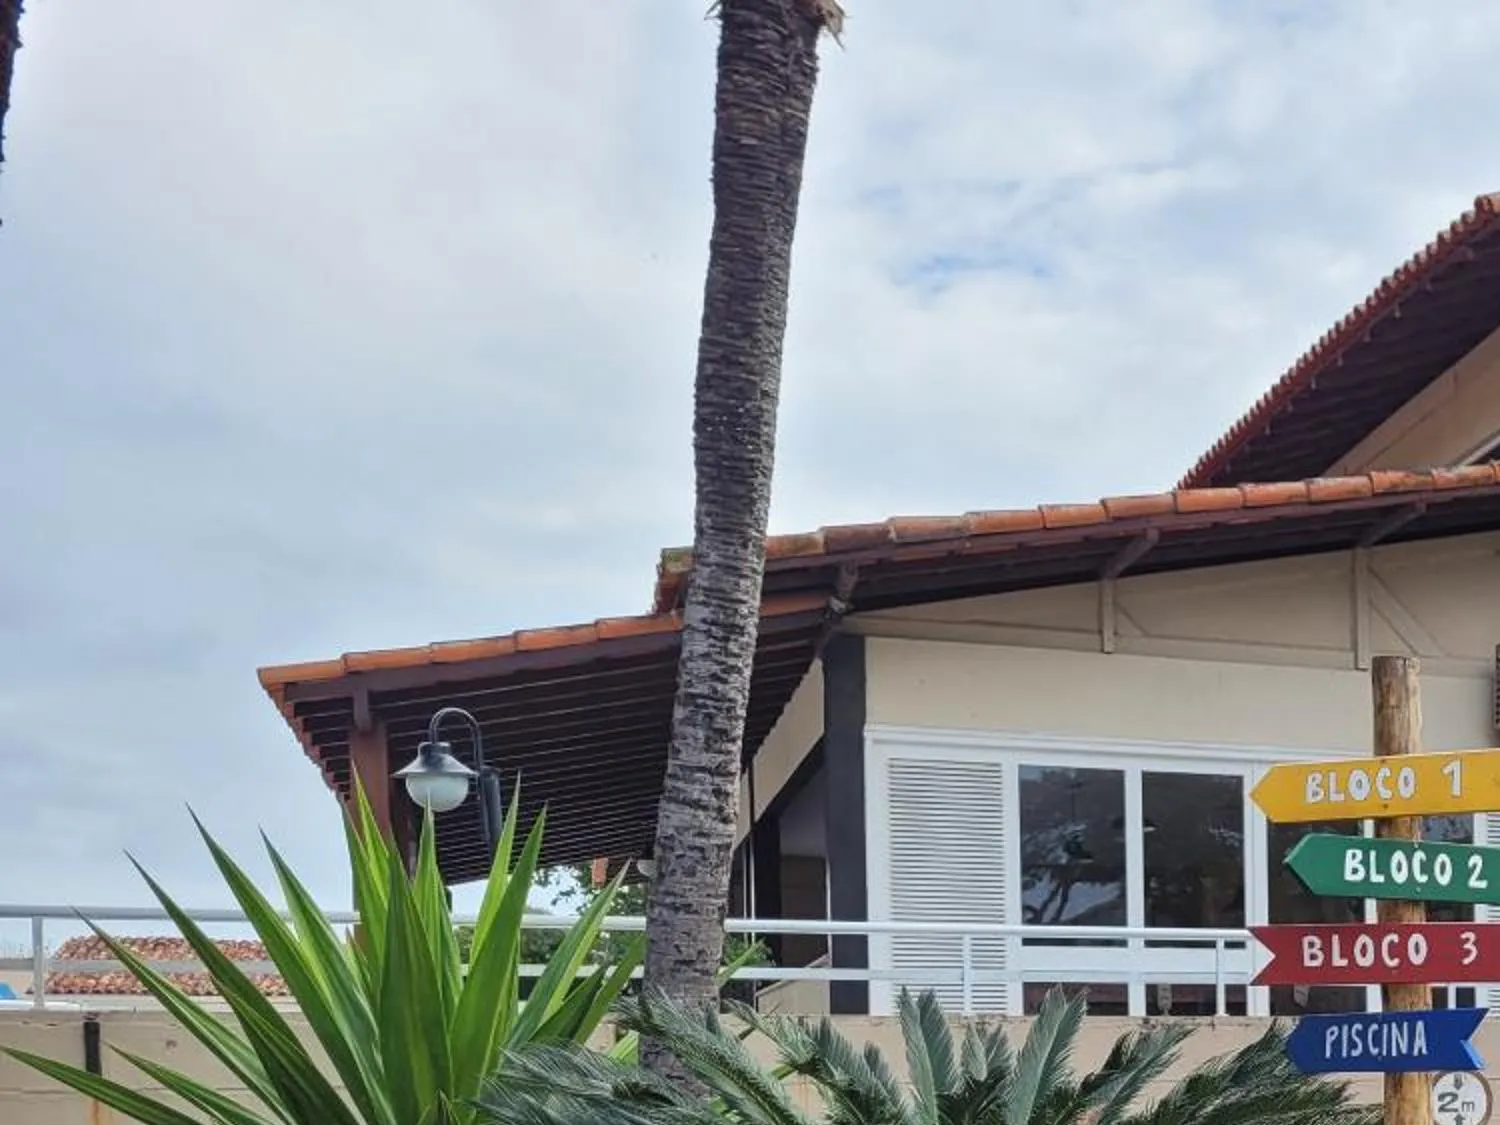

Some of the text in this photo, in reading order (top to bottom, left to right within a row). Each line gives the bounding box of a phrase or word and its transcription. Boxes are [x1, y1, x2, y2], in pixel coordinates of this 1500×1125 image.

[1305, 759, 1462, 804] BLOCO 1
[1343, 848, 1489, 889] BLOCO 2
[1301, 931, 1478, 968] BLOCO 3
[1324, 1019, 1428, 1059] PISCINA
